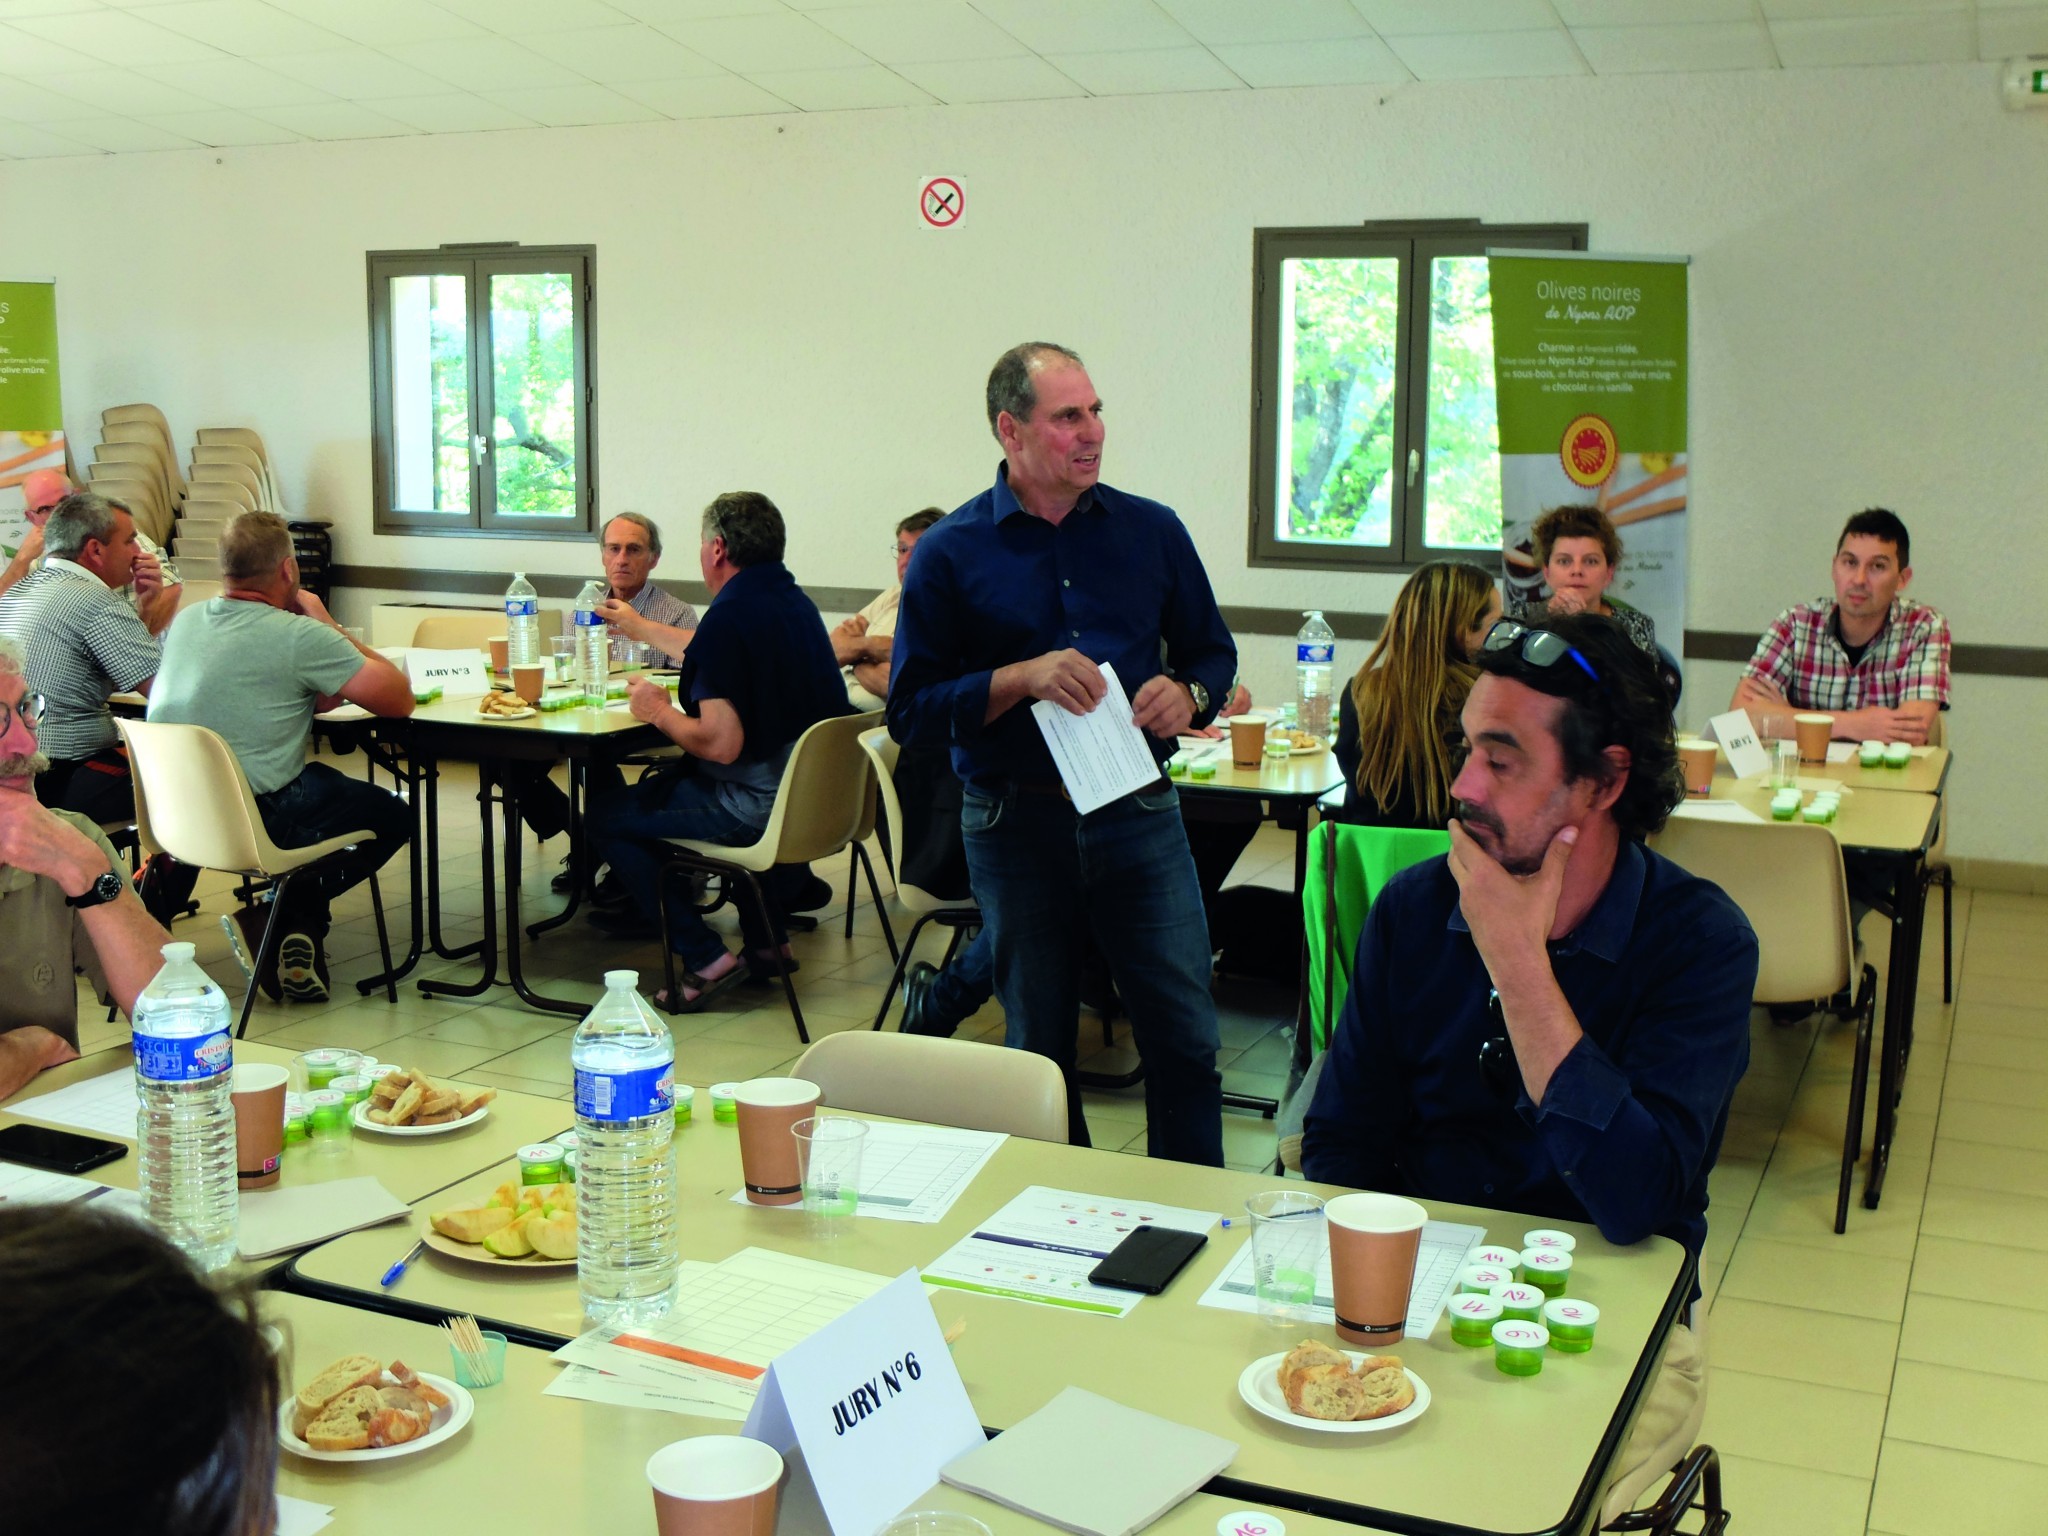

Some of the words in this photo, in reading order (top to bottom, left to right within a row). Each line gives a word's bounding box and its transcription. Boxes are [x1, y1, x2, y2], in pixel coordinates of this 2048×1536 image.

[1537, 280, 1587, 300] Olives
[1591, 282, 1641, 301] noires
[1544, 304, 1561, 319] de
[1562, 303, 1601, 324] Nyons
[1603, 304, 1637, 320] AOP
[1537, 342, 1576, 352] Charnue
[1548, 355, 1575, 368] Nyons
[1577, 355, 1595, 366] AOP
[1567, 368, 1590, 378] fruits
[1551, 382, 1587, 392] chocolat
[425, 669, 449, 677] JURY
[1481, 1252, 1504, 1263] 14
[1535, 1254, 1560, 1264] 15
[1501, 1289, 1531, 1301] 12
[831, 1376, 882, 1436] JURY
[881, 1351, 922, 1399] N°6
